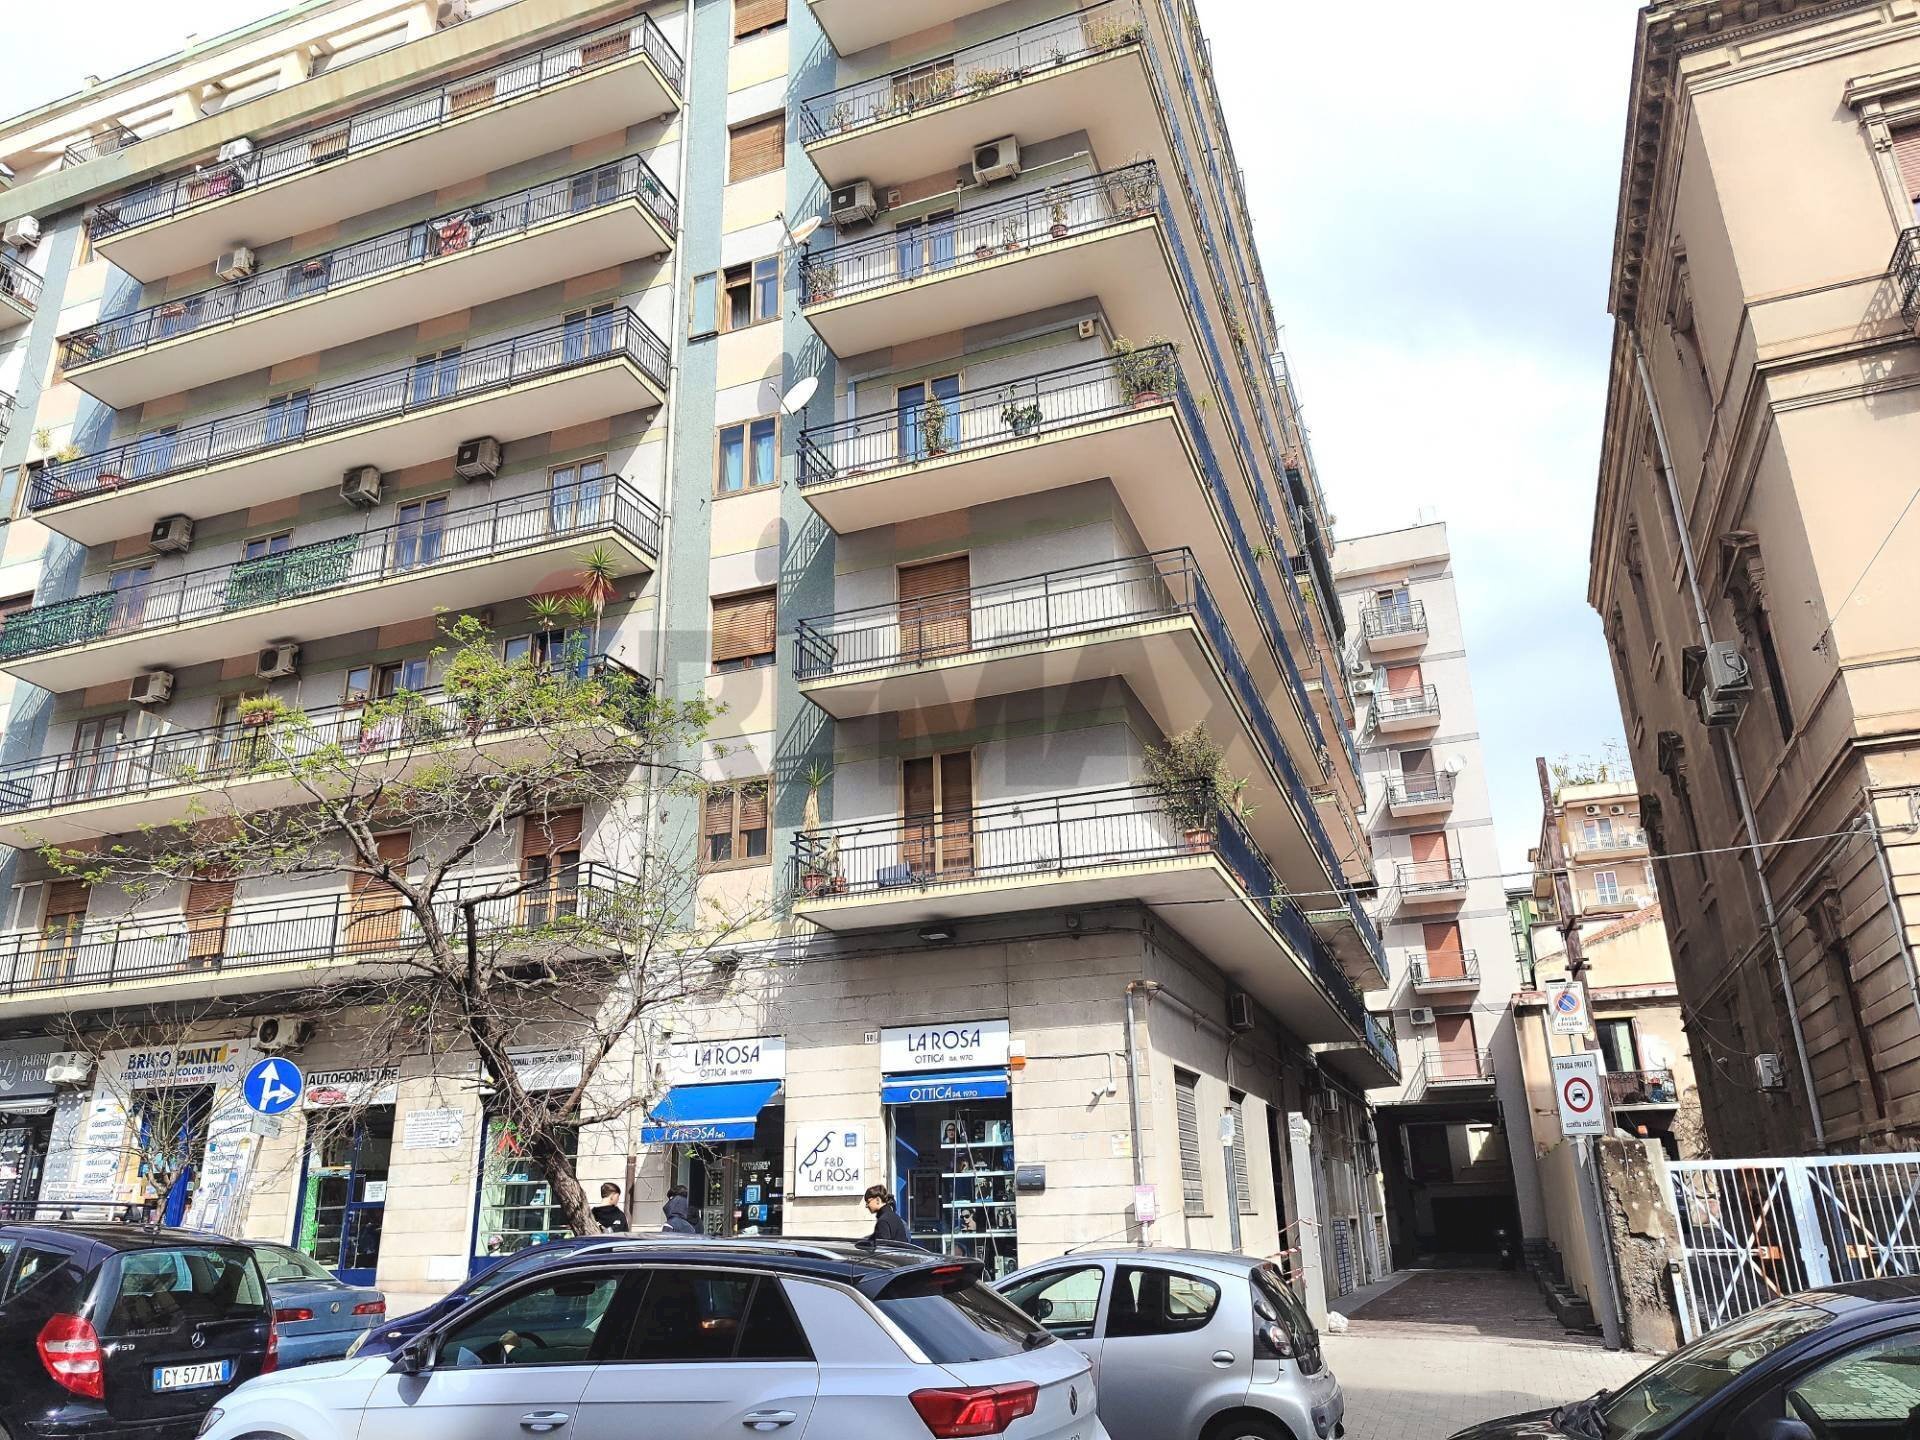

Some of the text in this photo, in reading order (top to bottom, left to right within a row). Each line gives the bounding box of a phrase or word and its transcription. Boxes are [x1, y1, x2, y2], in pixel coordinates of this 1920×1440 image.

[908, 1028, 980, 1052] LA ROSA
[177, 1046, 222, 1066] PAINT
[694, 1045, 760, 1067] LA ROSA
[914, 1053, 944, 1064] OTTICA
[959, 1054, 974, 1062] 1970
[177, 1065, 206, 1077] COLORI
[207, 1064, 235, 1074] BRUNO
[1556, 1060, 1593, 1070] STRADA PRIVATA
[700, 1067, 727, 1078] OTTICA
[910, 1086, 952, 1101] OTTICA
[824, 1156, 843, 1167] F&D
[809, 1168, 859, 1182] LA ROSA
[163, 1368, 181, 1386] CY
[183, 1363, 222, 1384] 577AX
